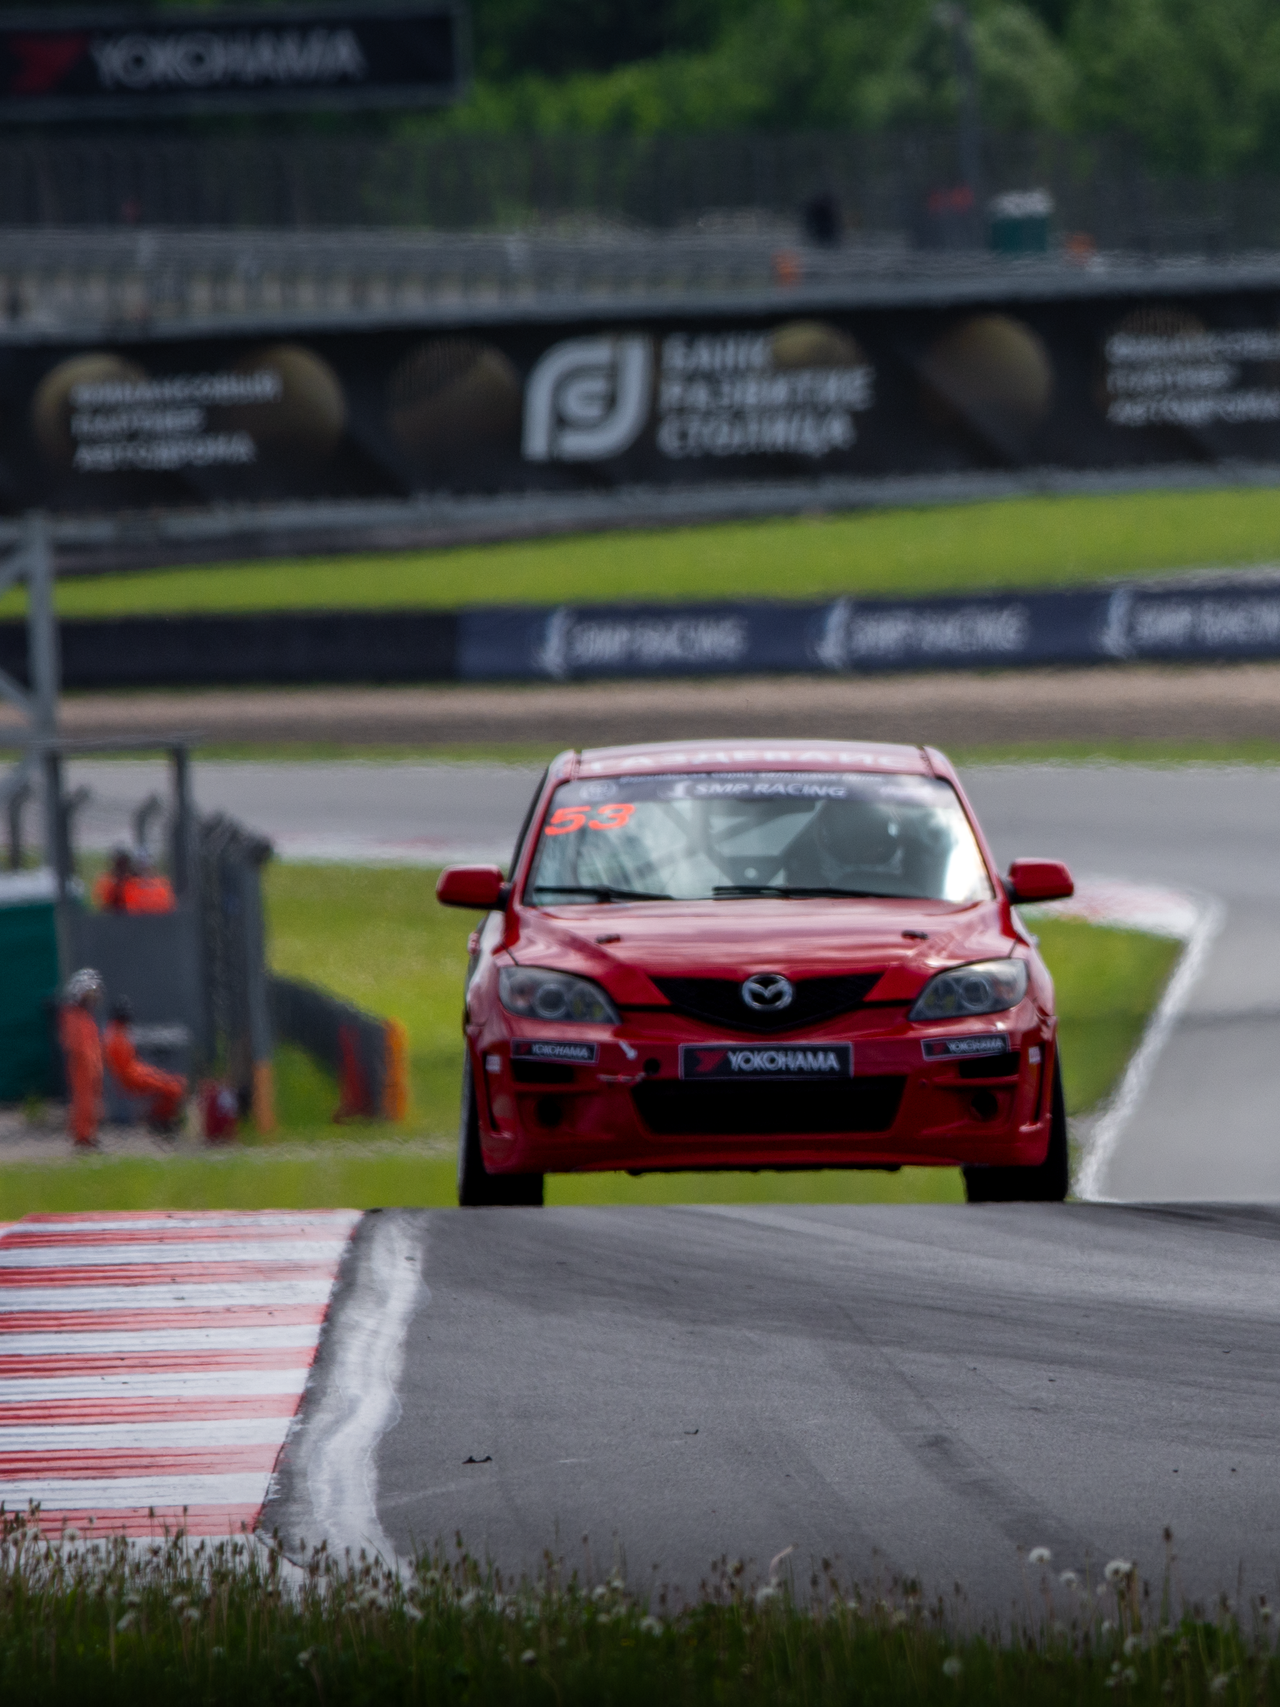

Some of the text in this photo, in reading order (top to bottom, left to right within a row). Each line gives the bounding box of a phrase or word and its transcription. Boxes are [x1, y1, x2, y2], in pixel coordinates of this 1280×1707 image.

[91, 29, 364, 88] YOKOHAMA
[632, 614, 747, 662] RACING
[915, 604, 1028, 652] RACING
[695, 782, 846, 798] SMP RACING
[544, 803, 636, 836] 53
[531, 1042, 590, 1060] YOKOHAMA
[946, 1037, 1004, 1053] YOKOHAMA
[727, 1050, 840, 1072] YOKOHAMA
